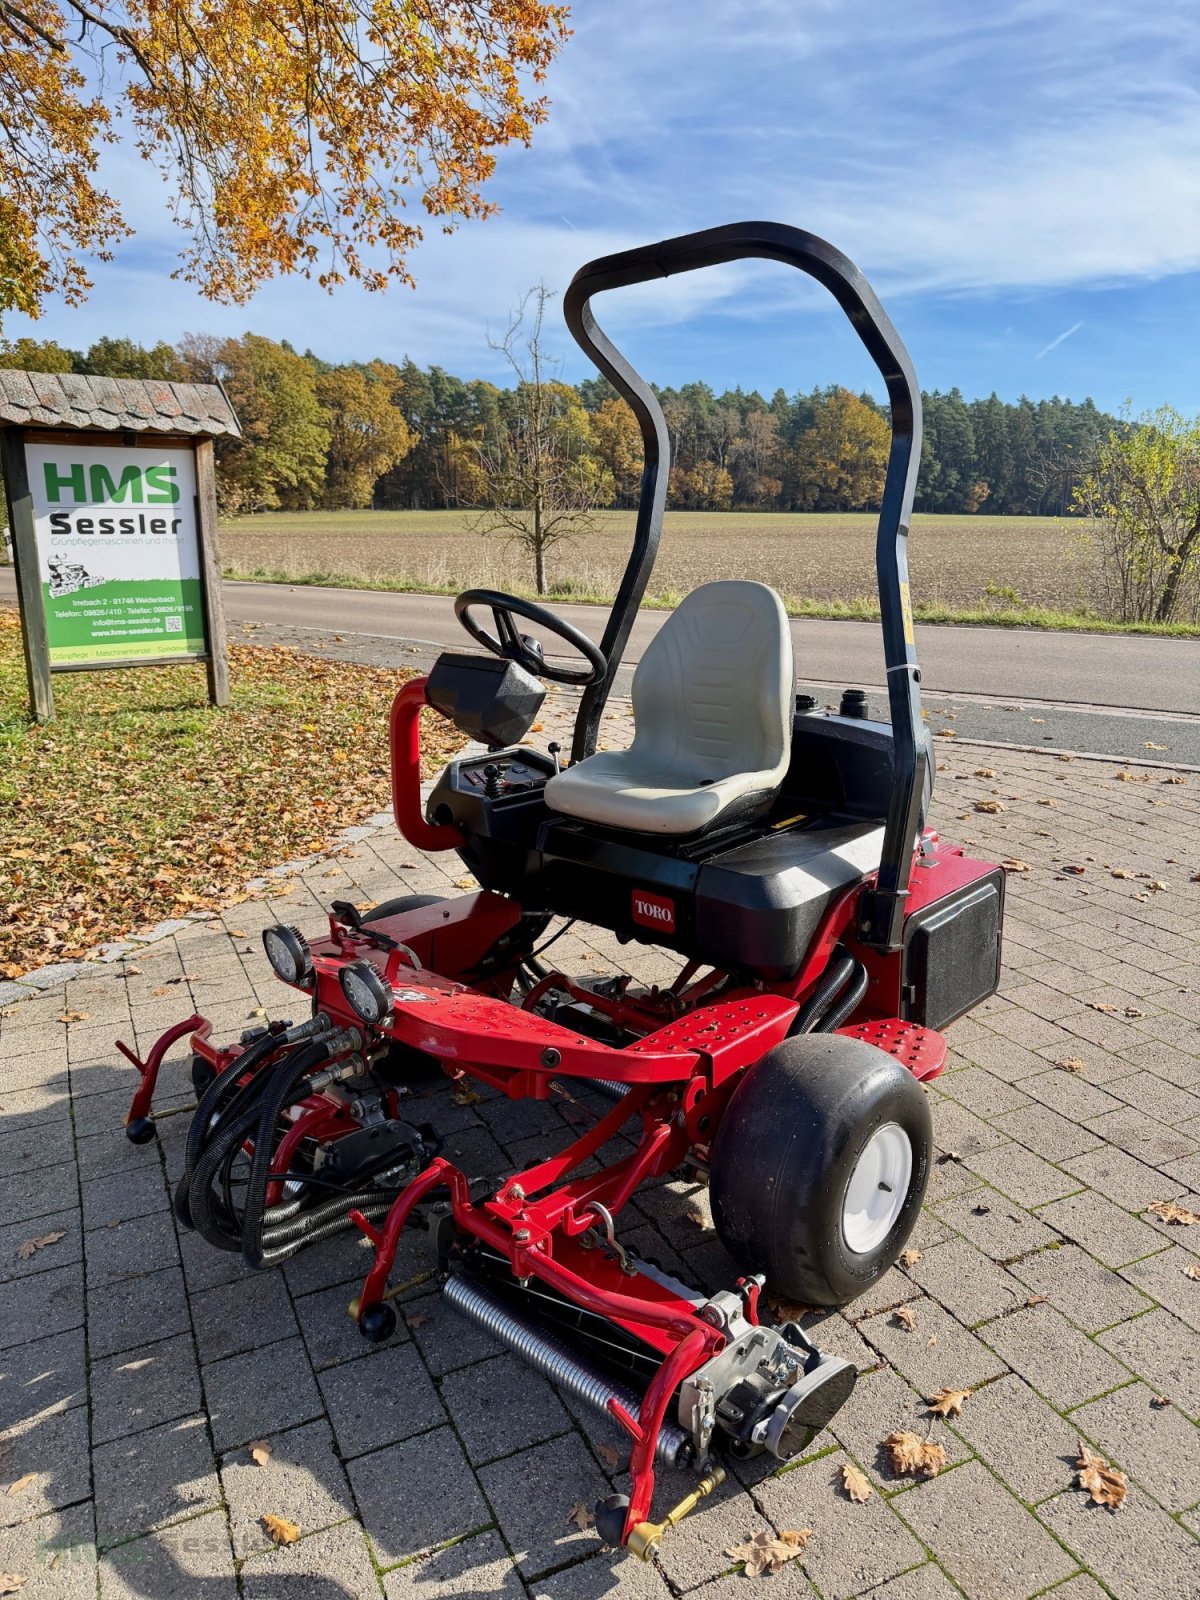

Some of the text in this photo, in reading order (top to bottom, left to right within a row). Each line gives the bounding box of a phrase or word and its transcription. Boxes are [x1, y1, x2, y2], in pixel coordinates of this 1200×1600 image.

[43, 463, 180, 504] HMS
[50, 513, 182, 535] Sessler
[54, 610, 82, 618] Telefon:
[90, 627, 164, 637] www.hms-sessler.de
[635, 900, 672, 922] TORO
